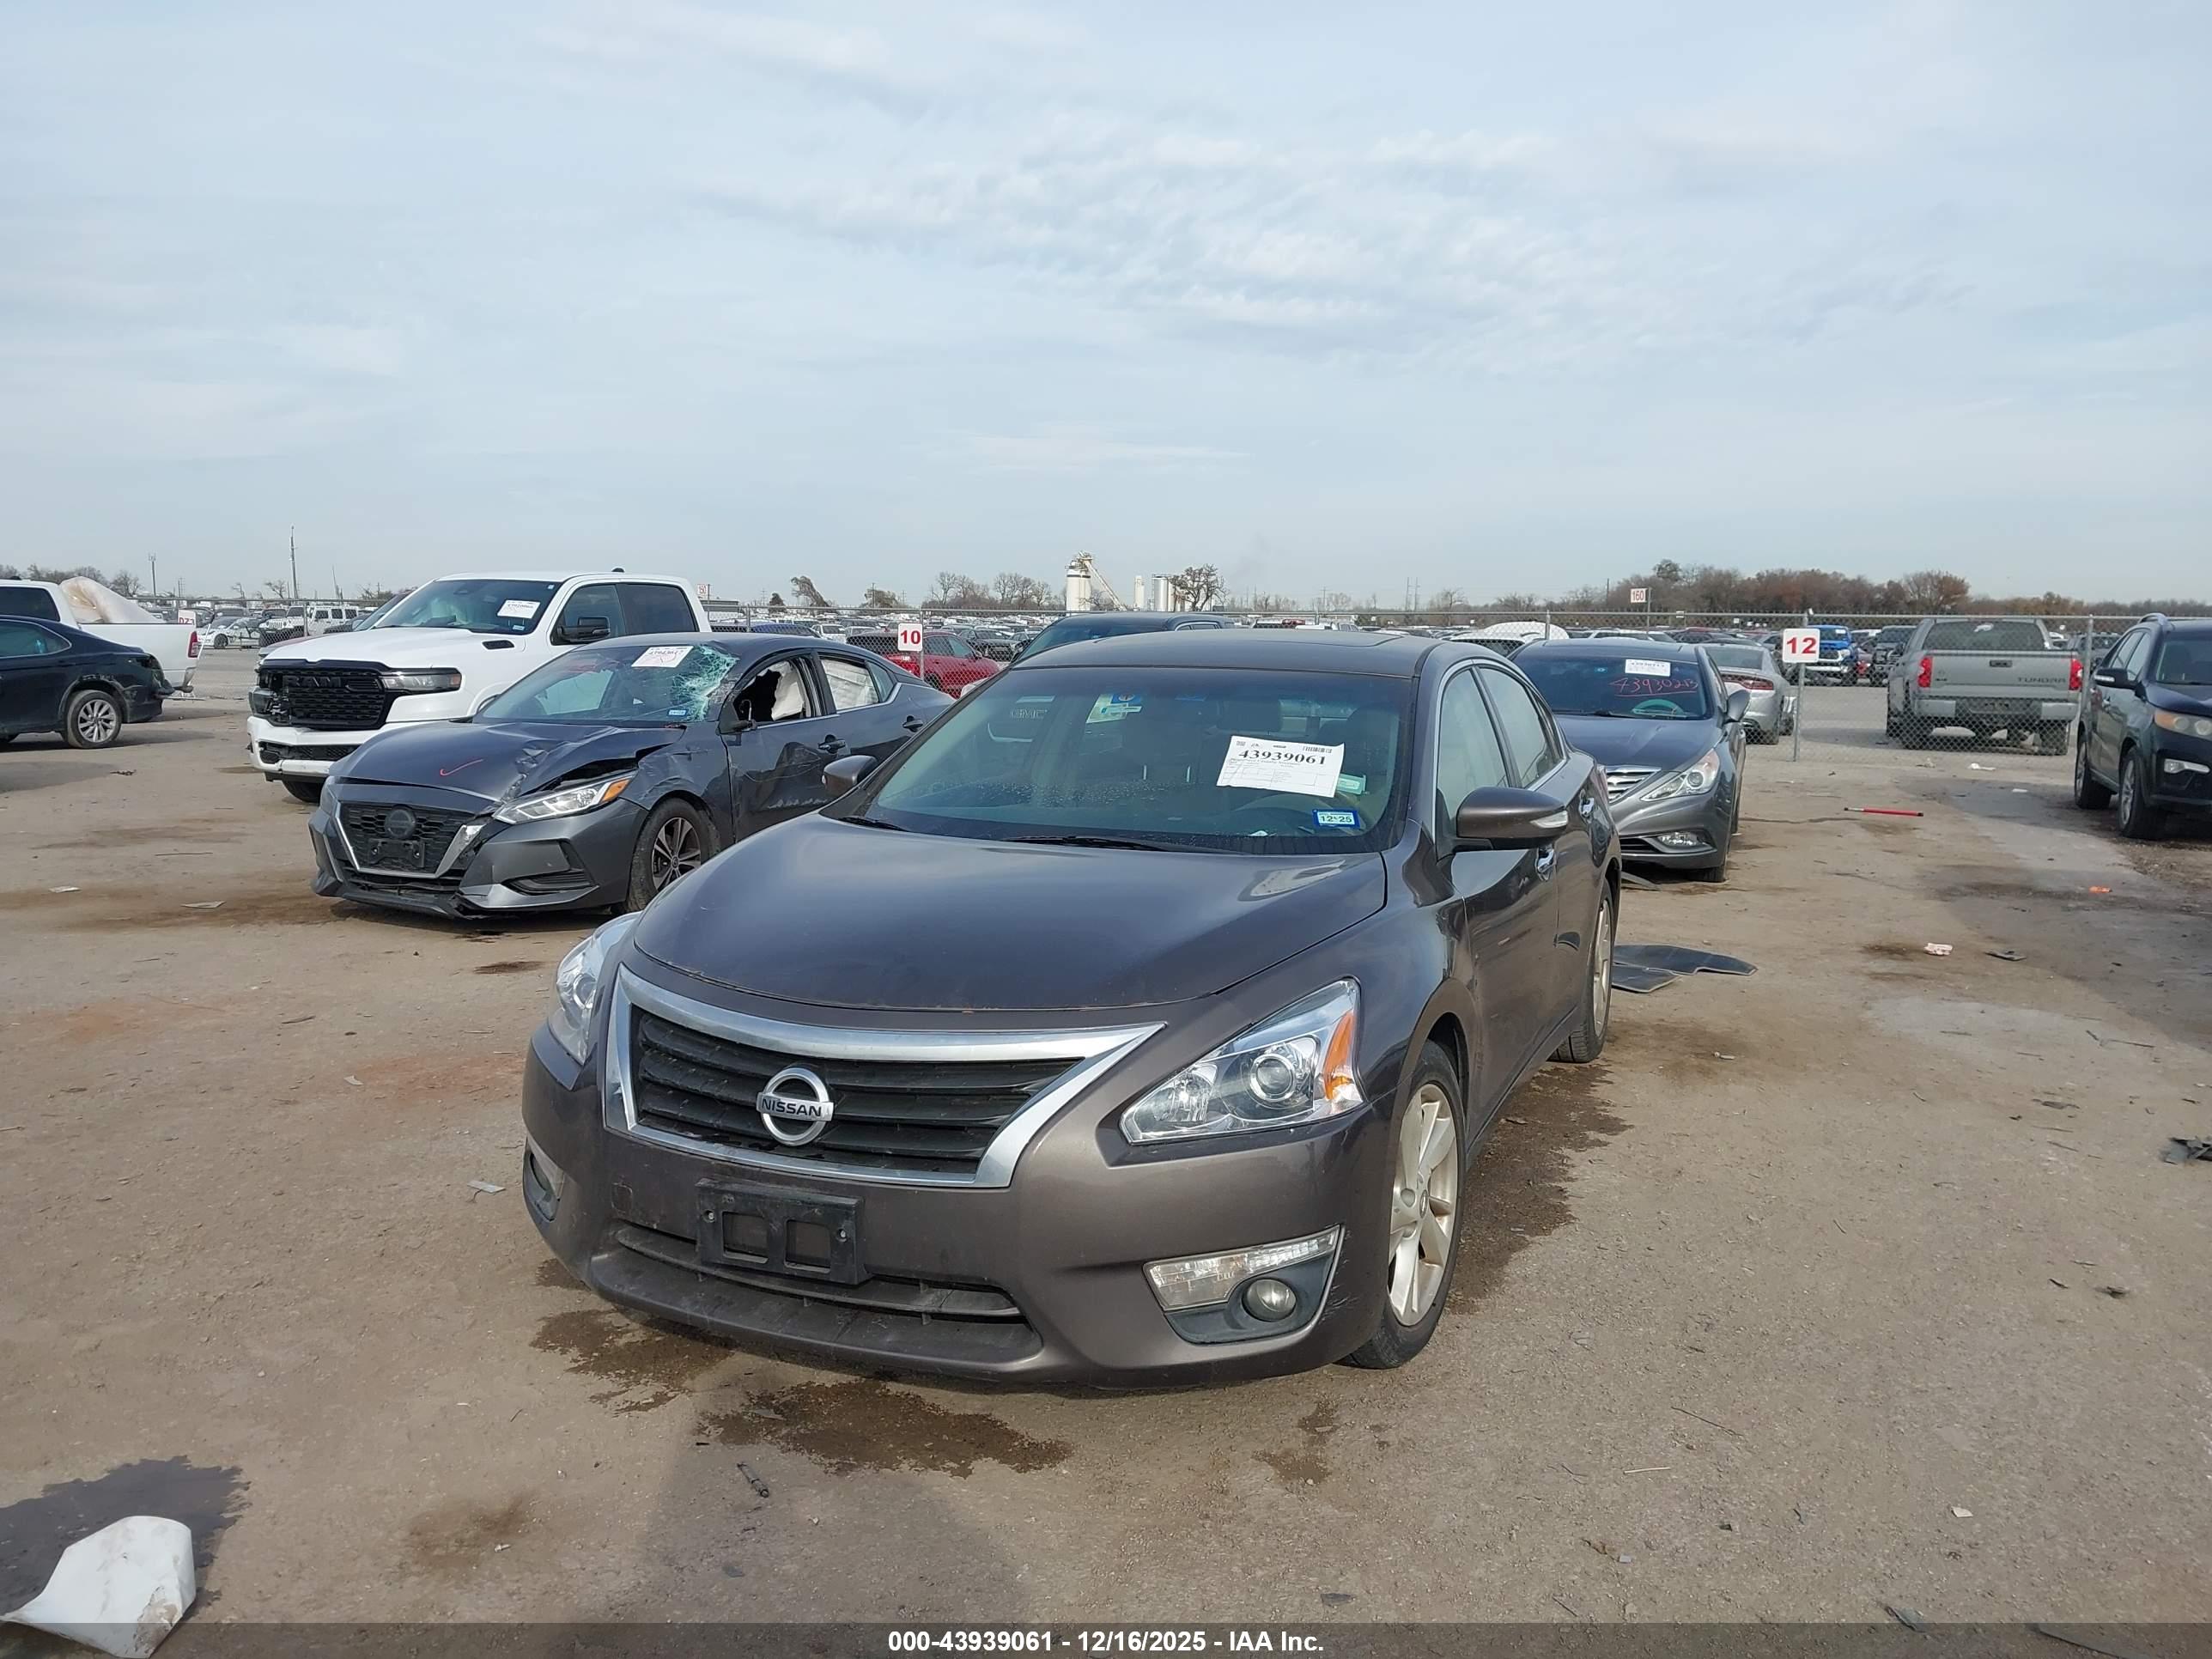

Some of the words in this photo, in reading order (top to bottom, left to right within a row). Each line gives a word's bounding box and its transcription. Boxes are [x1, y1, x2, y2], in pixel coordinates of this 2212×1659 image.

[1632, 590, 1644, 601] 160
[900, 629, 921, 645] 10
[1786, 636, 1817, 654] 12
[283, 675, 342, 688] RAM
[1238, 750, 1327, 765] 43939061
[762, 1098, 822, 1117] NISSAN
